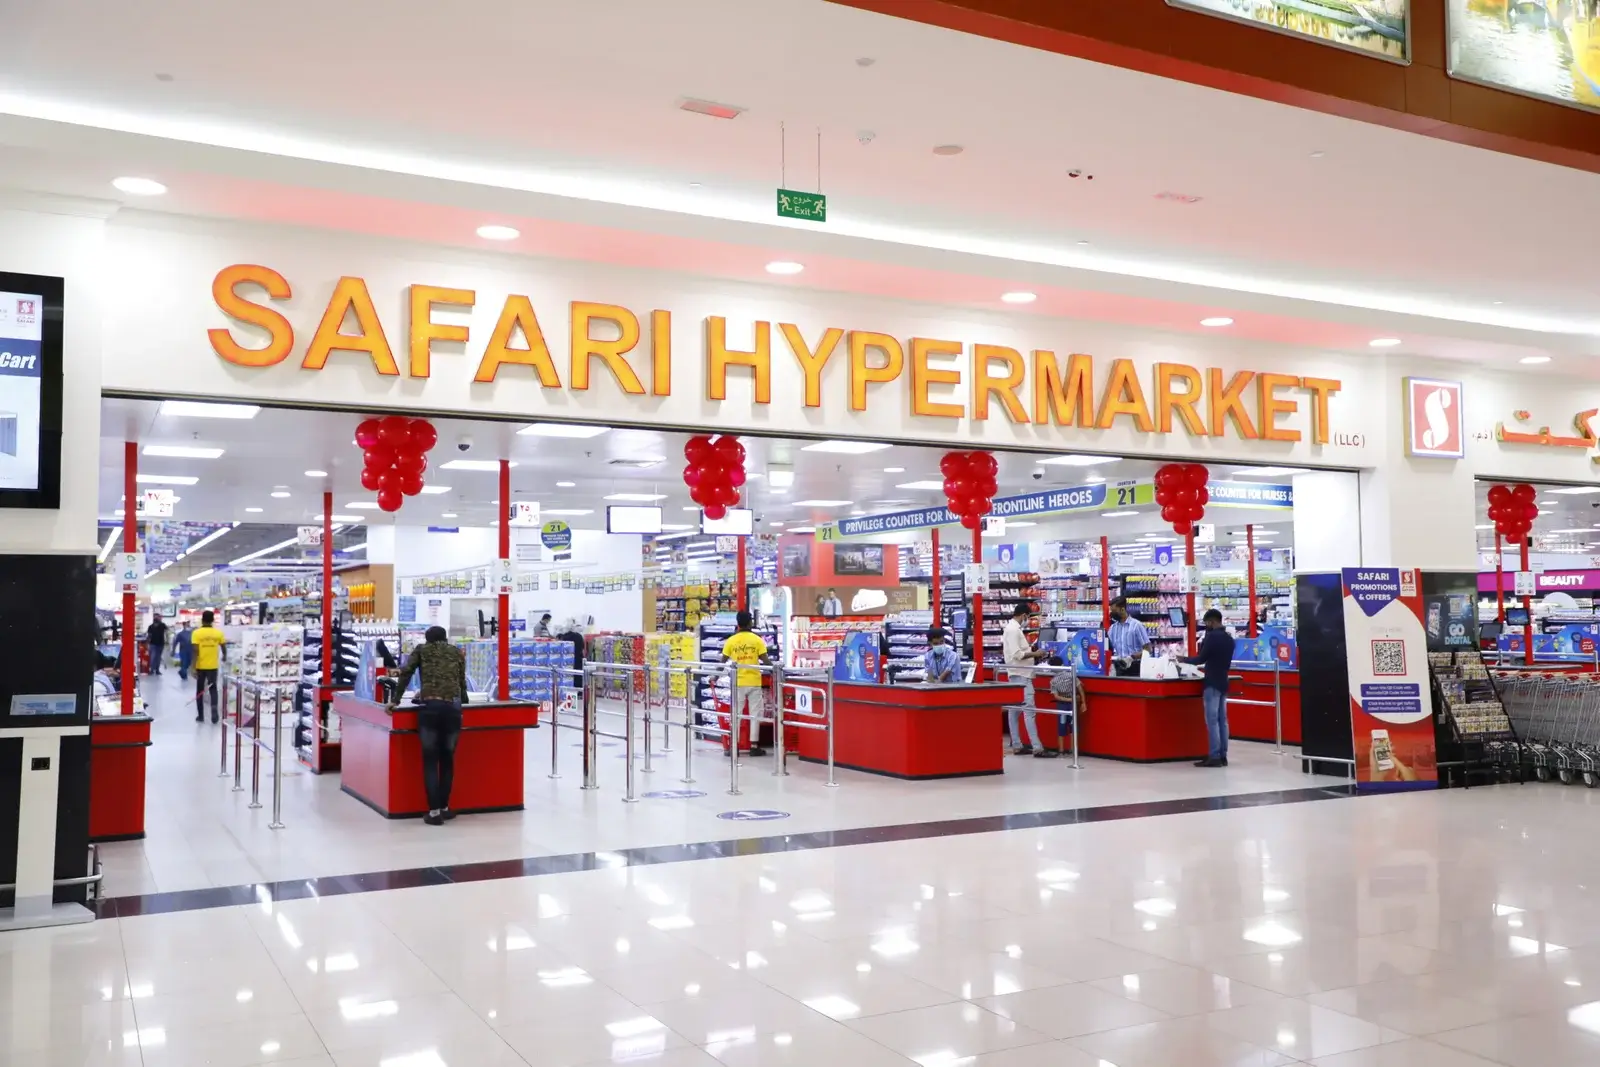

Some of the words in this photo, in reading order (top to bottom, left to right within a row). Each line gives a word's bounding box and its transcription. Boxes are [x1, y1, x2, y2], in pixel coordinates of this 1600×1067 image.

[795, 206, 811, 216] Exit
[207, 263, 672, 397] SAFARI
[705, 315, 1341, 445] HYPERMARKET
[1334, 431, 1365, 449] (LLC)
[1117, 486, 1135, 505] 21
[1262, 489, 1287, 502] NURSES
[992, 496, 1045, 515] FRONTLINE
[1048, 490, 1093, 508] HEROES
[845, 518, 883, 533] PRIVILEGE
[885, 512, 924, 528] COUNTER
[926, 510, 943, 523] FOR
[550, 524, 561, 532] 21
[822, 528, 832, 540] 21
[1357, 572, 1390, 581] SAFARI
[1539, 575, 1585, 586] BEAUTY
[1350, 583, 1398, 591] PROMOTIONS
[1358, 593, 1365, 601] &
[1365, 593, 1391, 601] OFFERS
[1448, 623, 1465, 637] GO
[1444, 636, 1472, 646] DIGITAL
